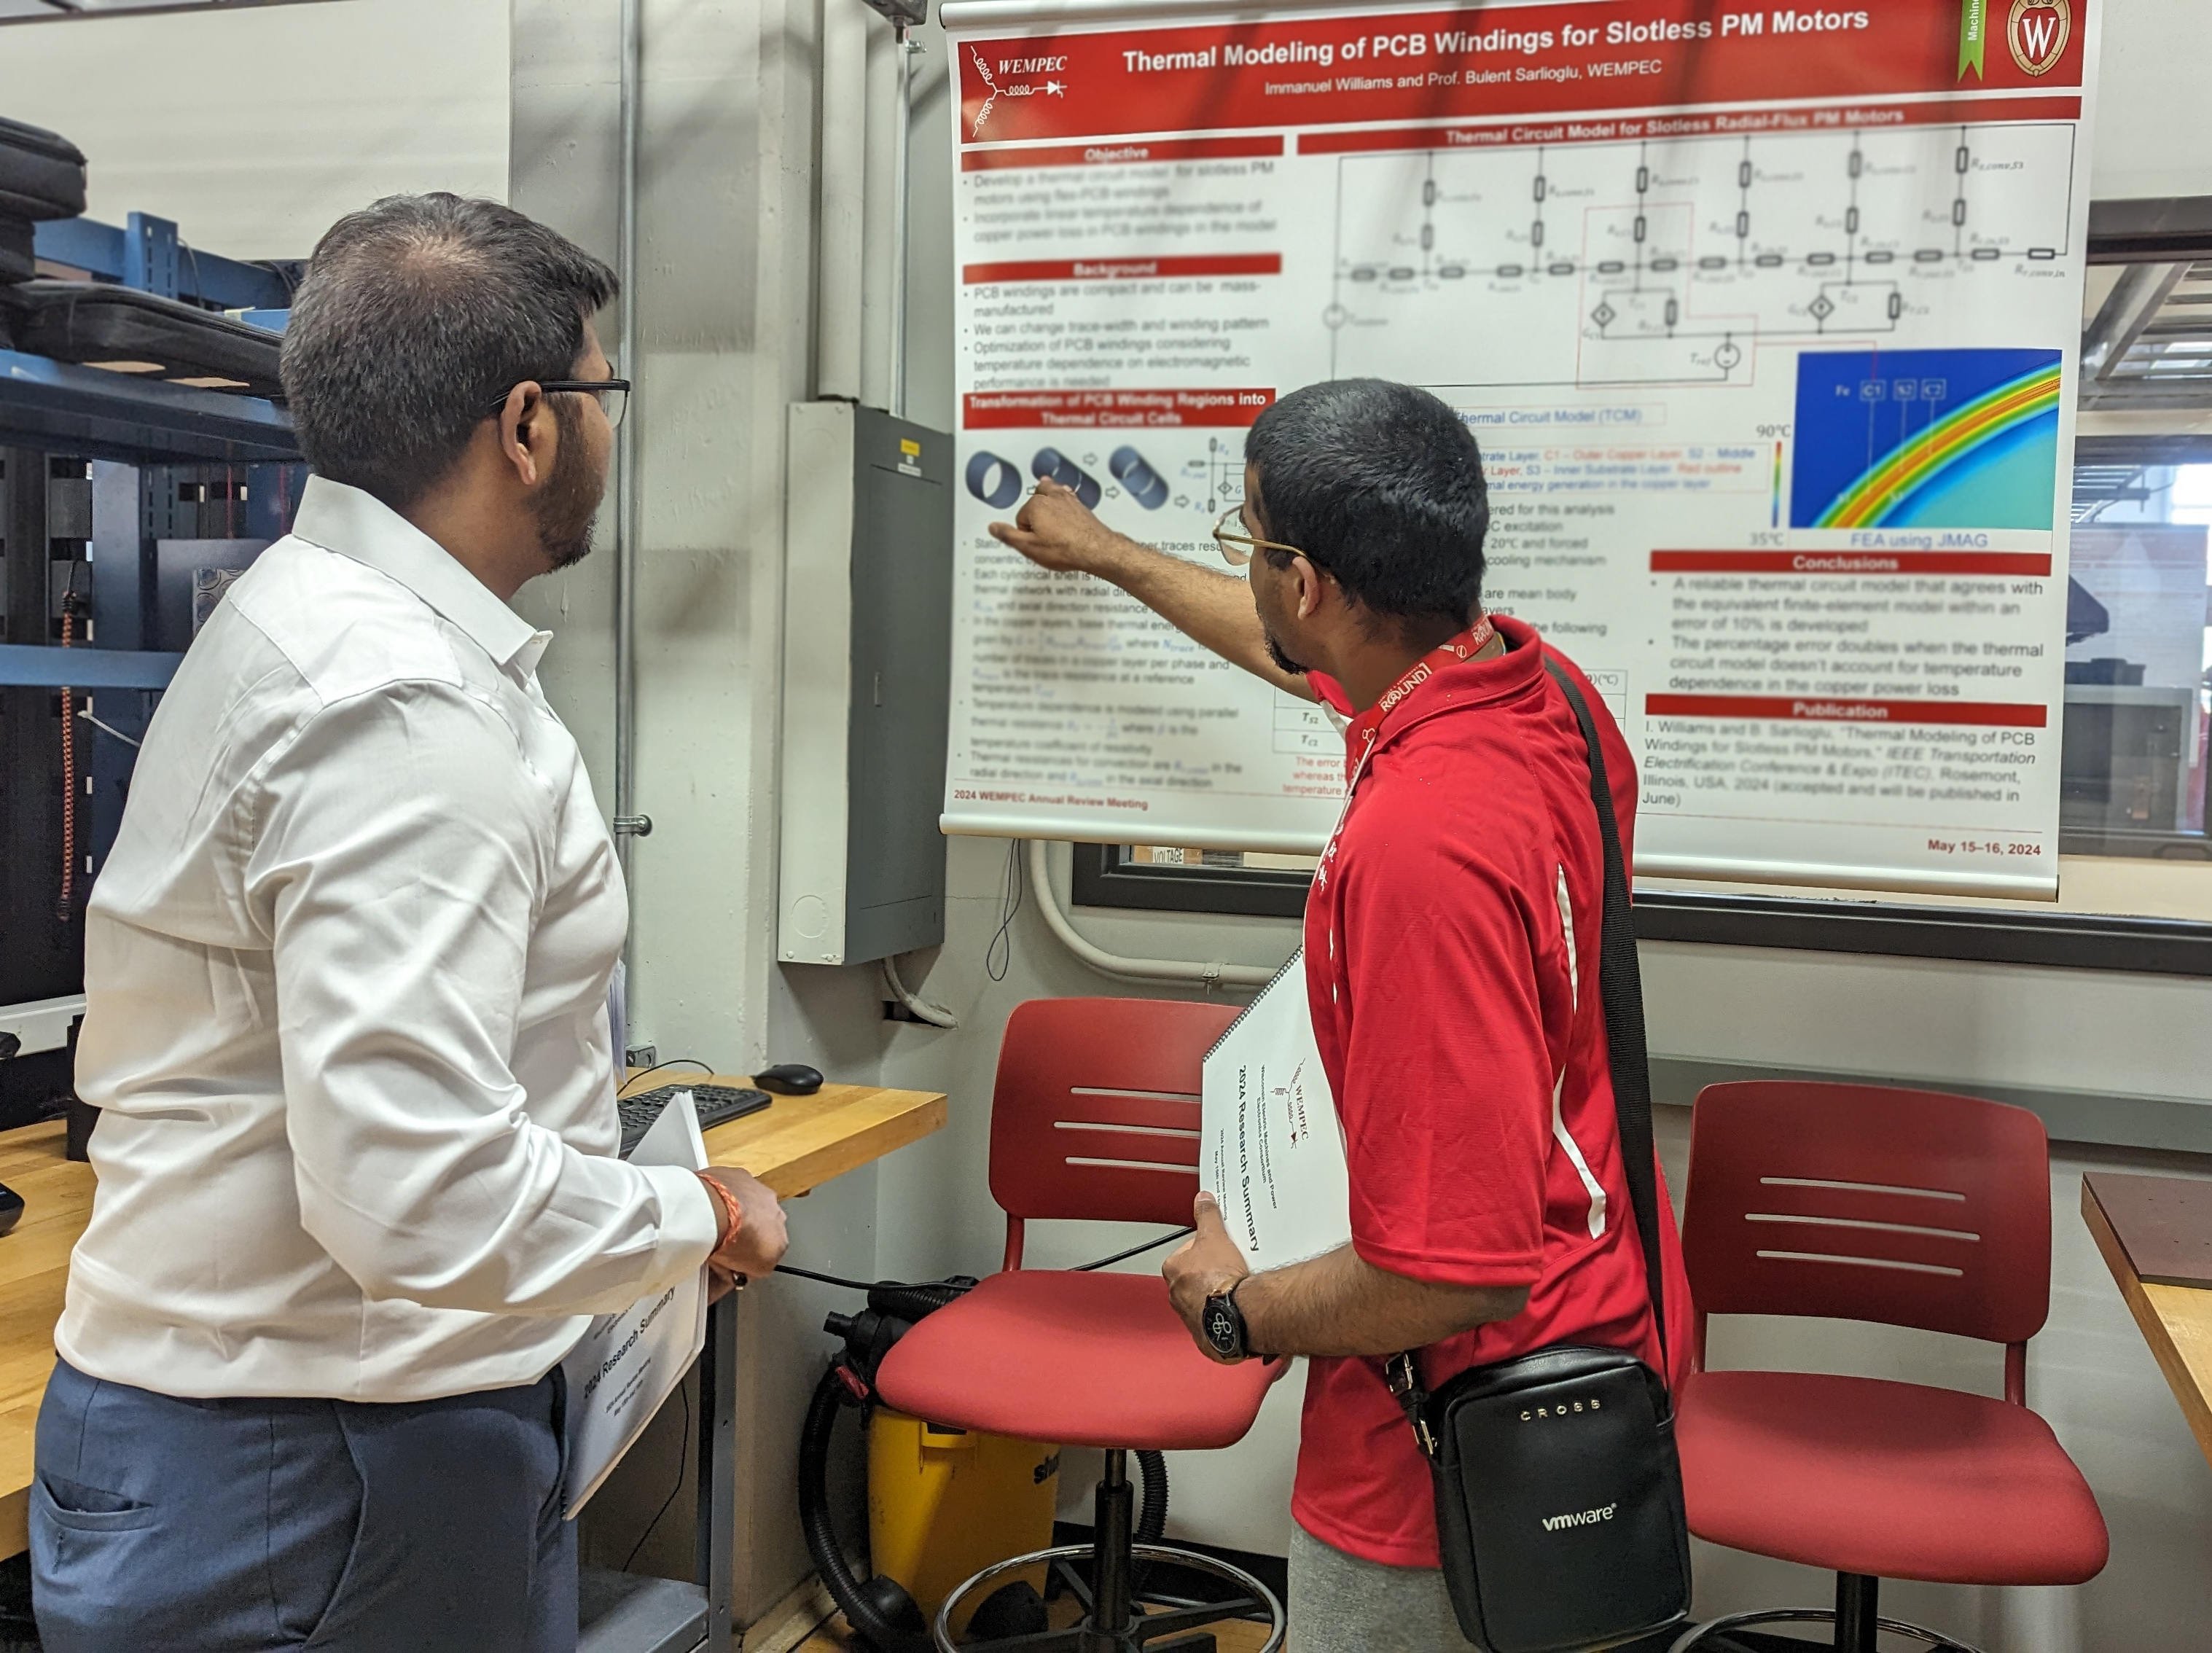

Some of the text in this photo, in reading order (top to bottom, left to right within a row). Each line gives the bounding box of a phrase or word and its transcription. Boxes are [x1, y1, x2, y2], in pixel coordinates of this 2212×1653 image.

[1124, 10, 1869, 72] Thermal Modeling of PCB Windings for Slotless PM Motors
[2023, 15, 2055, 58] W
[998, 56, 1067, 74] WEMPEC
[1265, 59, 1662, 96] Immanuel Williams and Prof. Bulent Sarlioglu, WEMPEC
[1446, 108, 1904, 144] Thermal Circuit Model for Slotless Radial-Flux PM Motors
[1085, 147, 1149, 163] Objective
[1176, 161, 1273, 178] for slotless PM
[1074, 262, 1157, 279] Background
[974, 285, 1055, 300] PCB windings
[974, 303, 1054, 318] manufactured
[974, 324, 992, 336] We
[996, 324, 1016, 335] can
[1020, 321, 1064, 337] change
[1170, 318, 1219, 334] winding
[1223, 317, 1269, 332] pattern
[974, 341, 1045, 356] Optimization
[1156, 336, 1230, 351] considering
[1863, 385, 1882, 396] C1
[1897, 384, 1913, 396] S2
[969, 392, 1266, 410] Transformation of PCB Winding Regions into
[1041, 410, 1181, 425] Thermal Circuit Cells
[1509, 410, 1551, 423] Circuit
[1555, 410, 1595, 423] Model
[1599, 408, 1642, 423] (TCM)
[1517, 504, 1615, 517] for this analysis
[1504, 521, 1563, 532] excitation
[1522, 538, 1545, 548] and
[1548, 537, 1588, 548] forced
[1851, 534, 1988, 550] FEA using JMAG
[1487, 555, 1606, 568] cooling mechanism
[1792, 555, 1899, 571] Conclusions
[1484, 588, 1577, 602] are mean body
[1950, 581, 2043, 596] agrees with
[1552, 623, 1607, 637] following
[1672, 636, 1700, 651] The
[1705, 638, 1790, 655] percentage
[1795, 641, 1832, 653] error
[1904, 641, 1947, 654] when
[1952, 641, 1977, 655] the
[1983, 642, 2043, 657] thermal
[1924, 662, 2022, 679] temperature
[1670, 676, 1763, 692] dependence
[1873, 681, 1921, 696] power
[1927, 681, 1960, 696] loss
[1793, 703, 1888, 719] Publication
[1659, 720, 1715, 735] Williams
[1910, 728, 1977, 746] Modeling
[1981, 731, 1997, 745] of
[2001, 732, 2035, 746] PCB
[1645, 738, 1708, 754] Windings
[1297, 757, 1340, 767] The error
[1886, 747, 2036, 765] IEEE Transportation
[1293, 771, 1334, 781] whereas
[1939, 767, 2021, 785] Rosemont,
[1283, 784, 1341, 795] temperature
[2006, 789, 2020, 802] in
[955, 790, 1148, 810] 2024 WEMPEC Annual Review Meeting
[1643, 792, 1681, 808] June)
[1154, 848, 1182, 863] VOLTAGE
[1928, 839, 1955, 854] May
[2008, 843, 2041, 856] 2024
[1295, 1085, 1309, 1141] WEMPEC
[1239, 1101, 1248, 1174] Research
[1263, 1132, 1271, 1168] Machines
[1242, 1175, 1259, 1251] Summary
[602, 1328, 639, 1378] Research
[639, 1286, 676, 1333] Summary
[1520, 1399, 1601, 1421] CROSS
